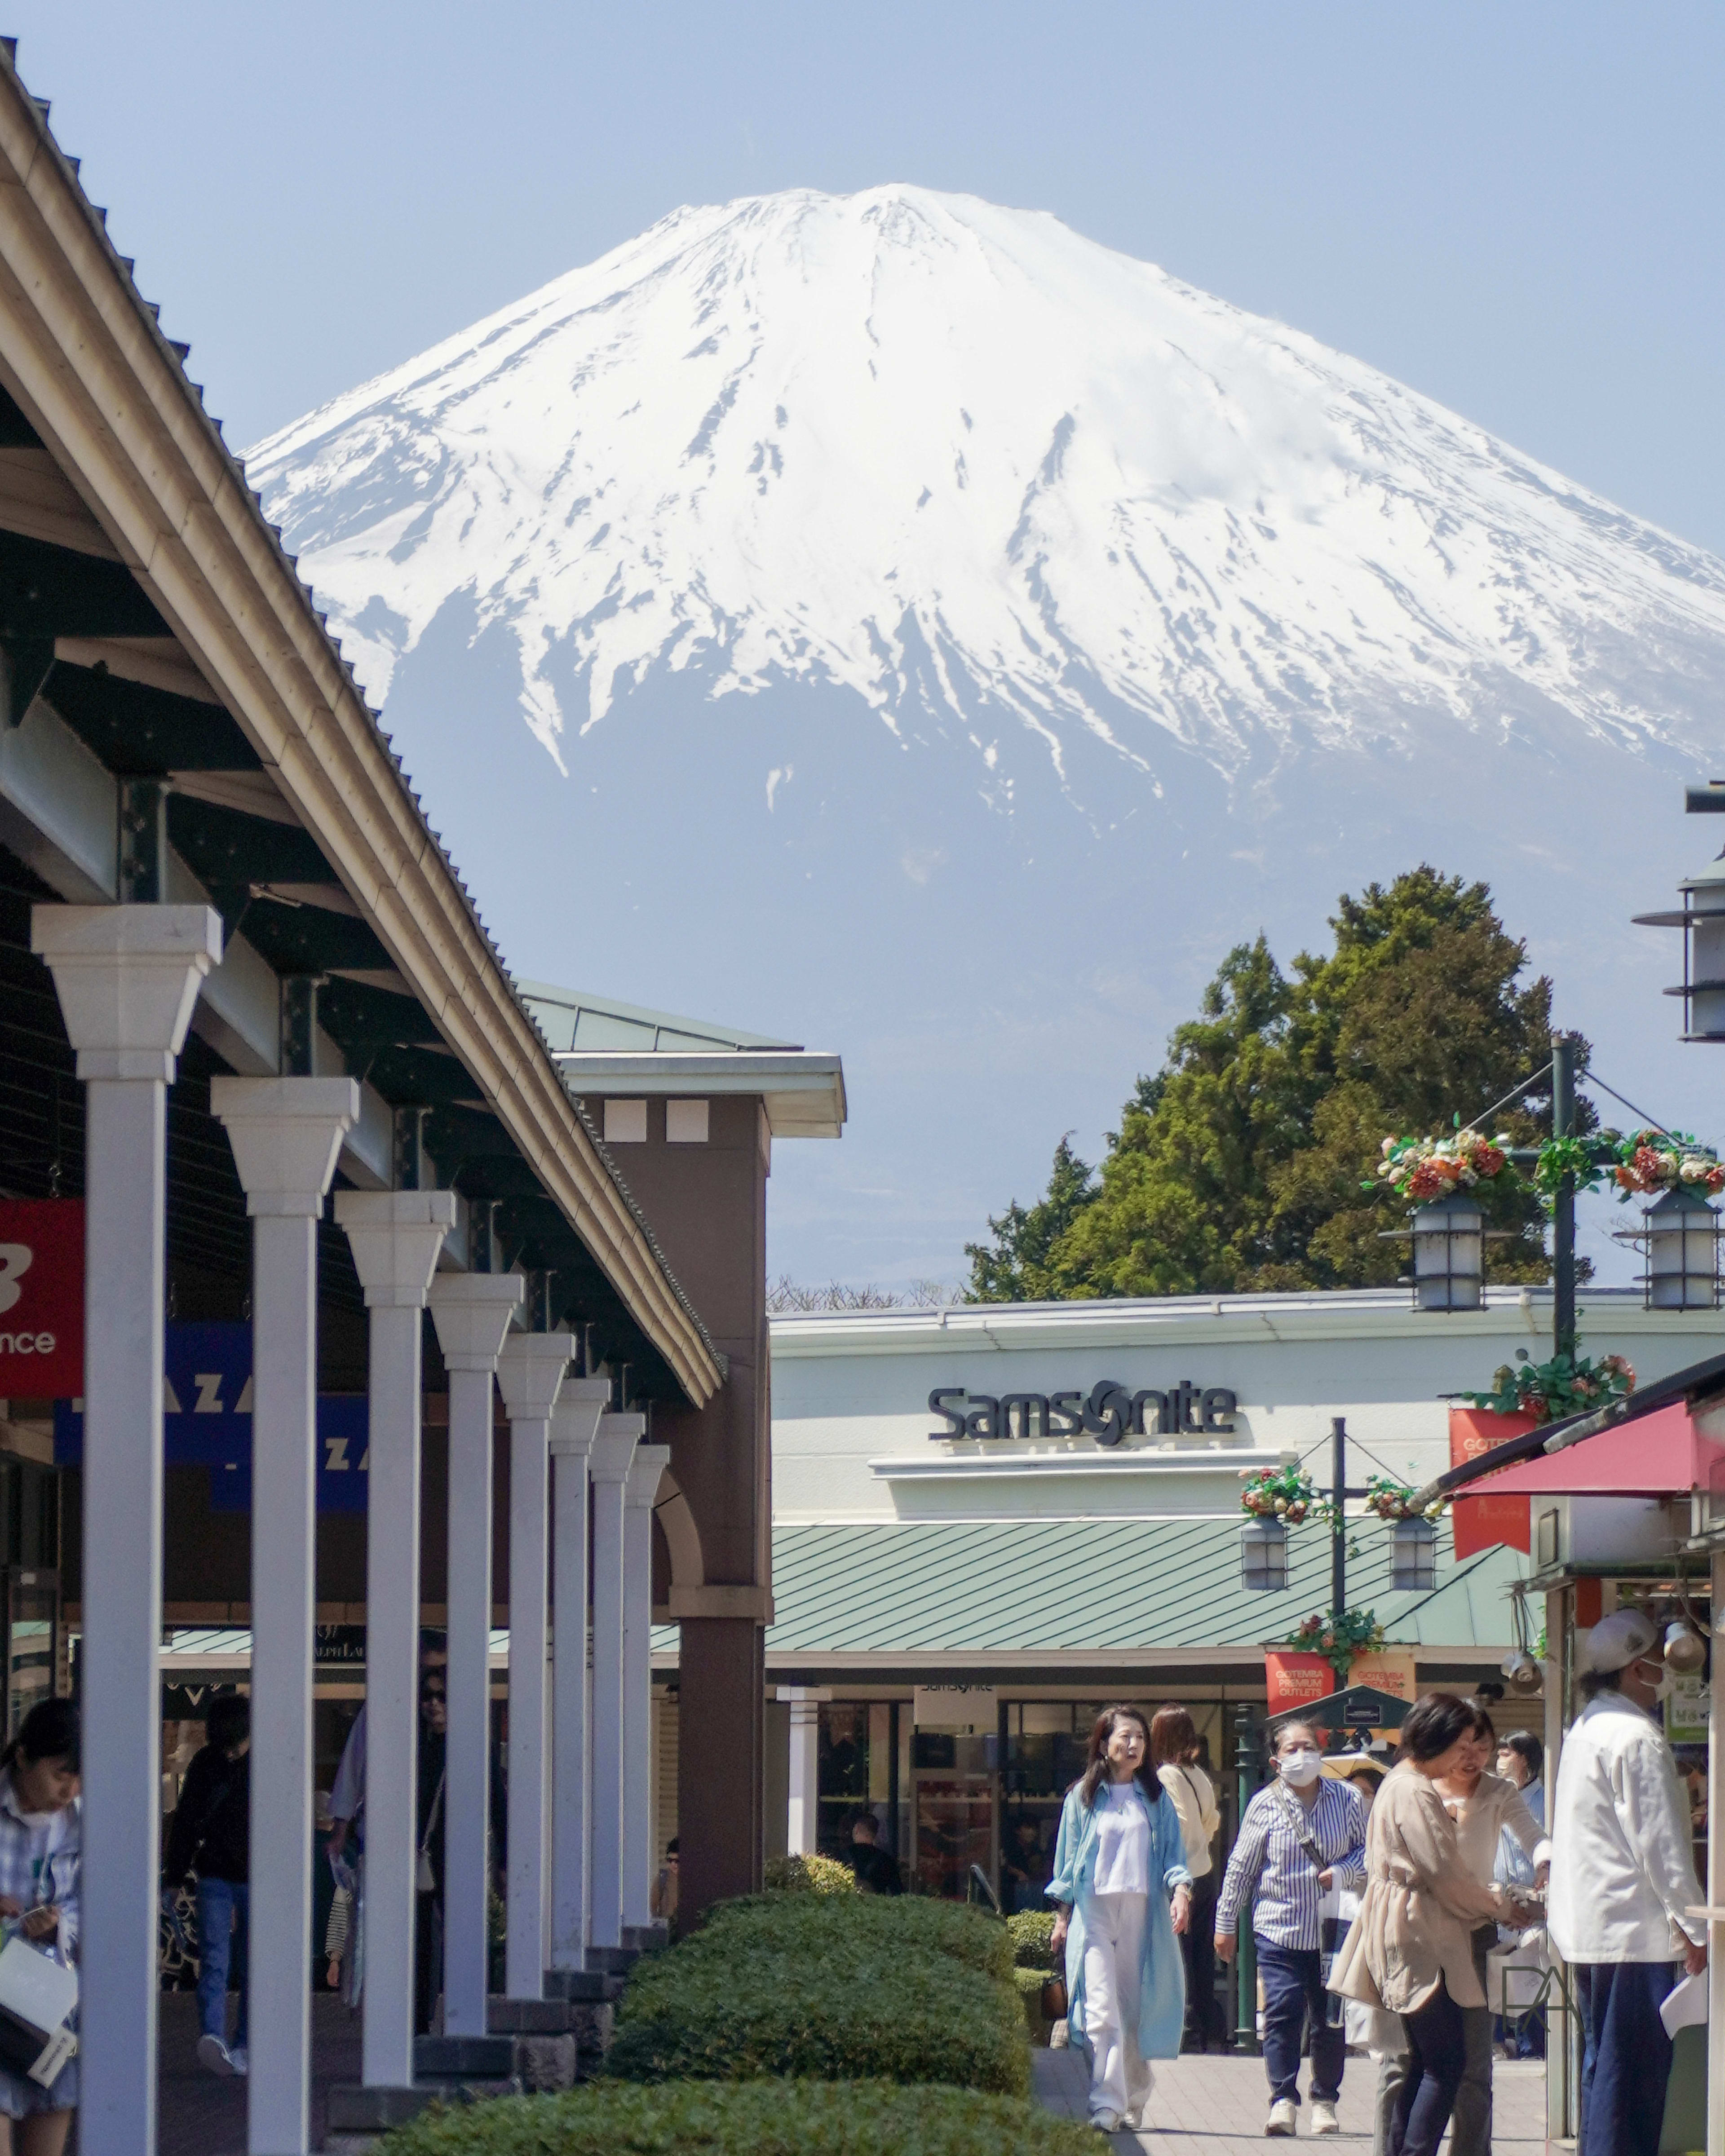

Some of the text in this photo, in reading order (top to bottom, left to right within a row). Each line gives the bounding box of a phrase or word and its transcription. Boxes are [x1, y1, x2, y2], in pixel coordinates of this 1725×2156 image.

[928, 1380, 1236, 1446] Samsonite
[1276, 1670, 1323, 1679] GOTEMBA
[1358, 1671, 1405, 1680] GOTEMBA
[1278, 1679, 1322, 1688] PREMIUM
[1279, 1688, 1322, 1697] OUTLETS
